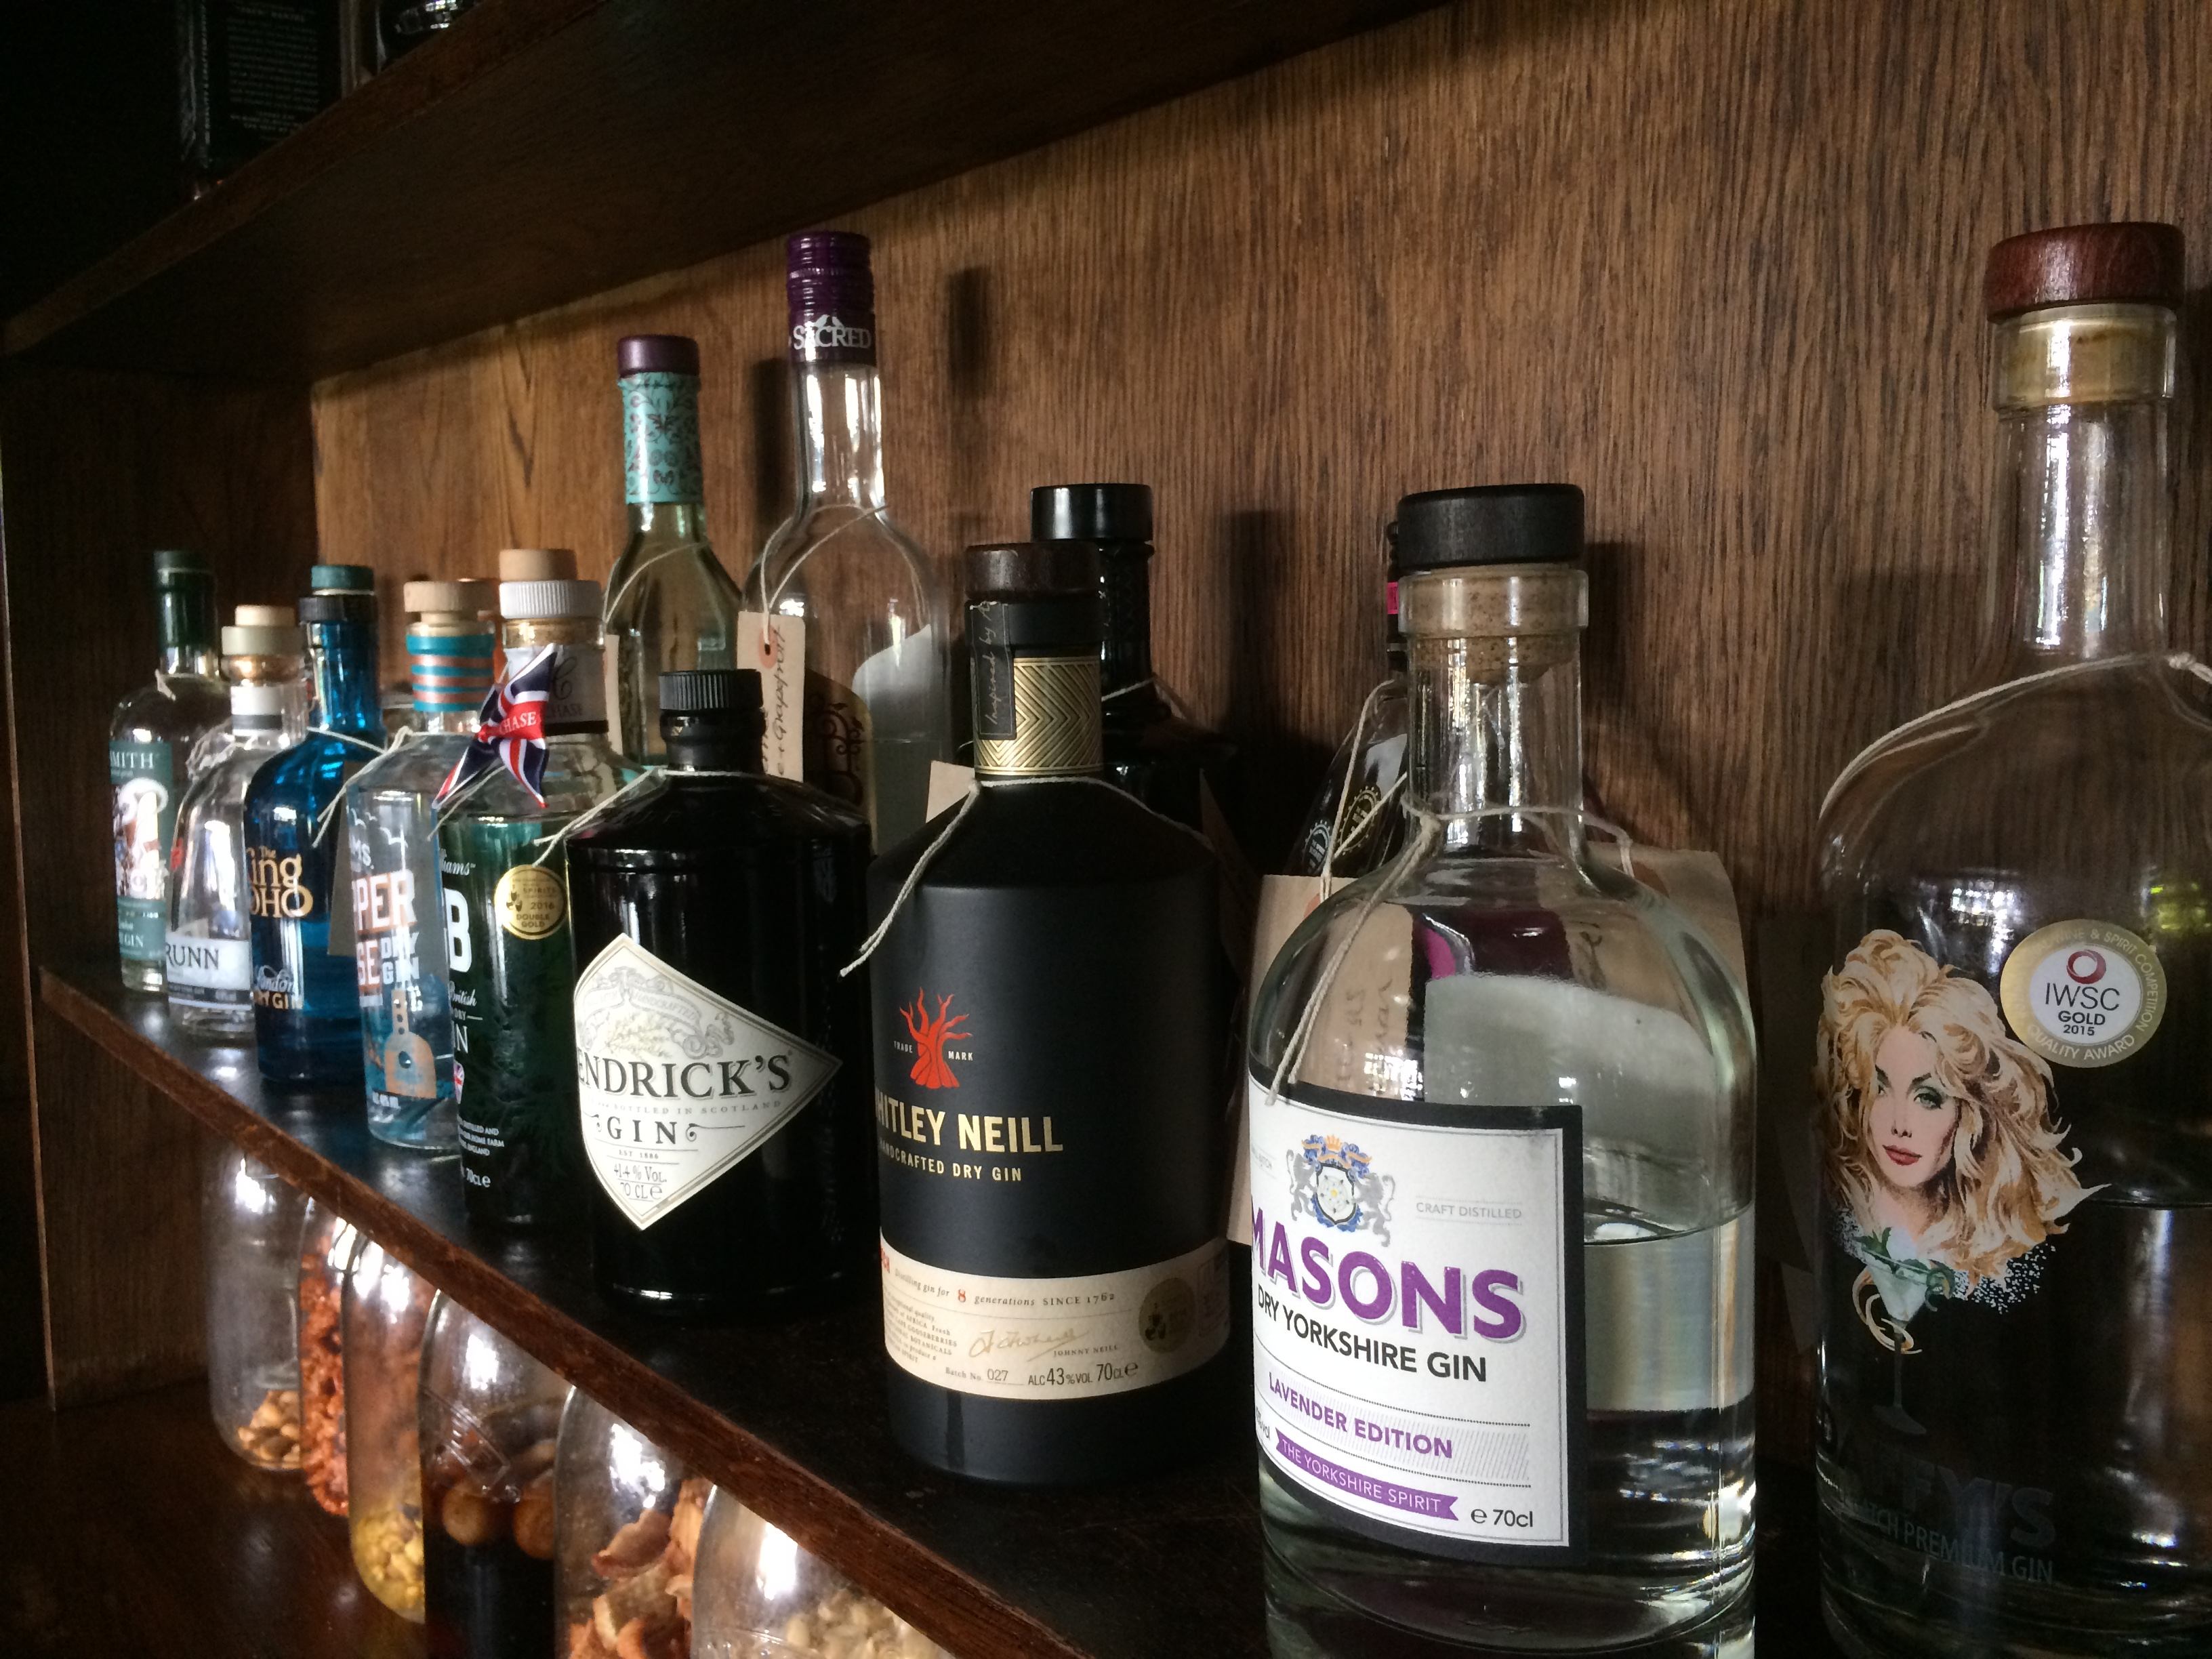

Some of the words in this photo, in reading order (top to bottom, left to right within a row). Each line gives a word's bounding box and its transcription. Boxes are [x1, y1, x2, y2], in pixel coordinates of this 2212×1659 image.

[979, 627, 997, 645] by
[548, 702, 583, 718] HASE
[499, 711, 537, 735] CHASE
[352, 869, 418, 931] PER
[531, 901, 555, 910] 2016
[441, 888, 472, 973] B
[2090, 928, 2100, 940] &
[2104, 931, 2138, 954] SPIRIT
[2135, 953, 2158, 1032] COMPETITION
[2045, 982, 2121, 1012] IWSC
[2057, 1010, 2106, 1025] GOLD
[2063, 1024, 2095, 1036] 2015
[893, 1040, 913, 1053] TRADE
[948, 1050, 973, 1061] MARK
[2028, 1024, 2081, 1060] QUALITY
[2083, 1034, 2135, 1061] AWARD
[701, 1100, 781, 1115] SCOTLAND
[485, 1127, 499, 1136] AND
[607, 1116, 677, 1145] GIN
[958, 1113, 1063, 1153] NEILL
[640, 1150, 659, 1160] 1886
[953, 1163, 982, 1180] DRY
[992, 1167, 1021, 1182] GIN
[1416, 1202, 1456, 1215] CRAFT
[1458, 1206, 1522, 1219] DISTILLED
[1252, 1196, 1525, 1343] MASONS
[923, 1284, 935, 1293] gin
[937, 1286, 950, 1297] for
[958, 1289, 966, 1303] 8
[974, 1295, 1036, 1307] generations
[1043, 1296, 1081, 1306] SINCE
[1087, 1292, 1115, 1305] 1762
[1258, 1284, 1279, 1322] DRY
[1283, 1304, 1417, 1373] YORKSHIRE
[1427, 1351, 1486, 1382] GIN
[1053, 1348, 1090, 1357] JOHNNY
[1093, 1344, 1118, 1354] NEILL
[945, 1366, 967, 1378] Batch
[987, 1368, 1009, 1382] 027
[1269, 1372, 1348, 1433] LAVENDER
[1355, 1417, 1452, 1458] EDITION
[1282, 1439, 1302, 1464] THE
[1304, 1454, 1382, 1499] YORKSHIRE
[1388, 1488, 1441, 1513] SPIRIT
[1492, 1509, 1533, 1528] 70cl
[1904, 1519, 2005, 1576] PREMIUM
[2011, 1554, 2054, 1584] GIN
